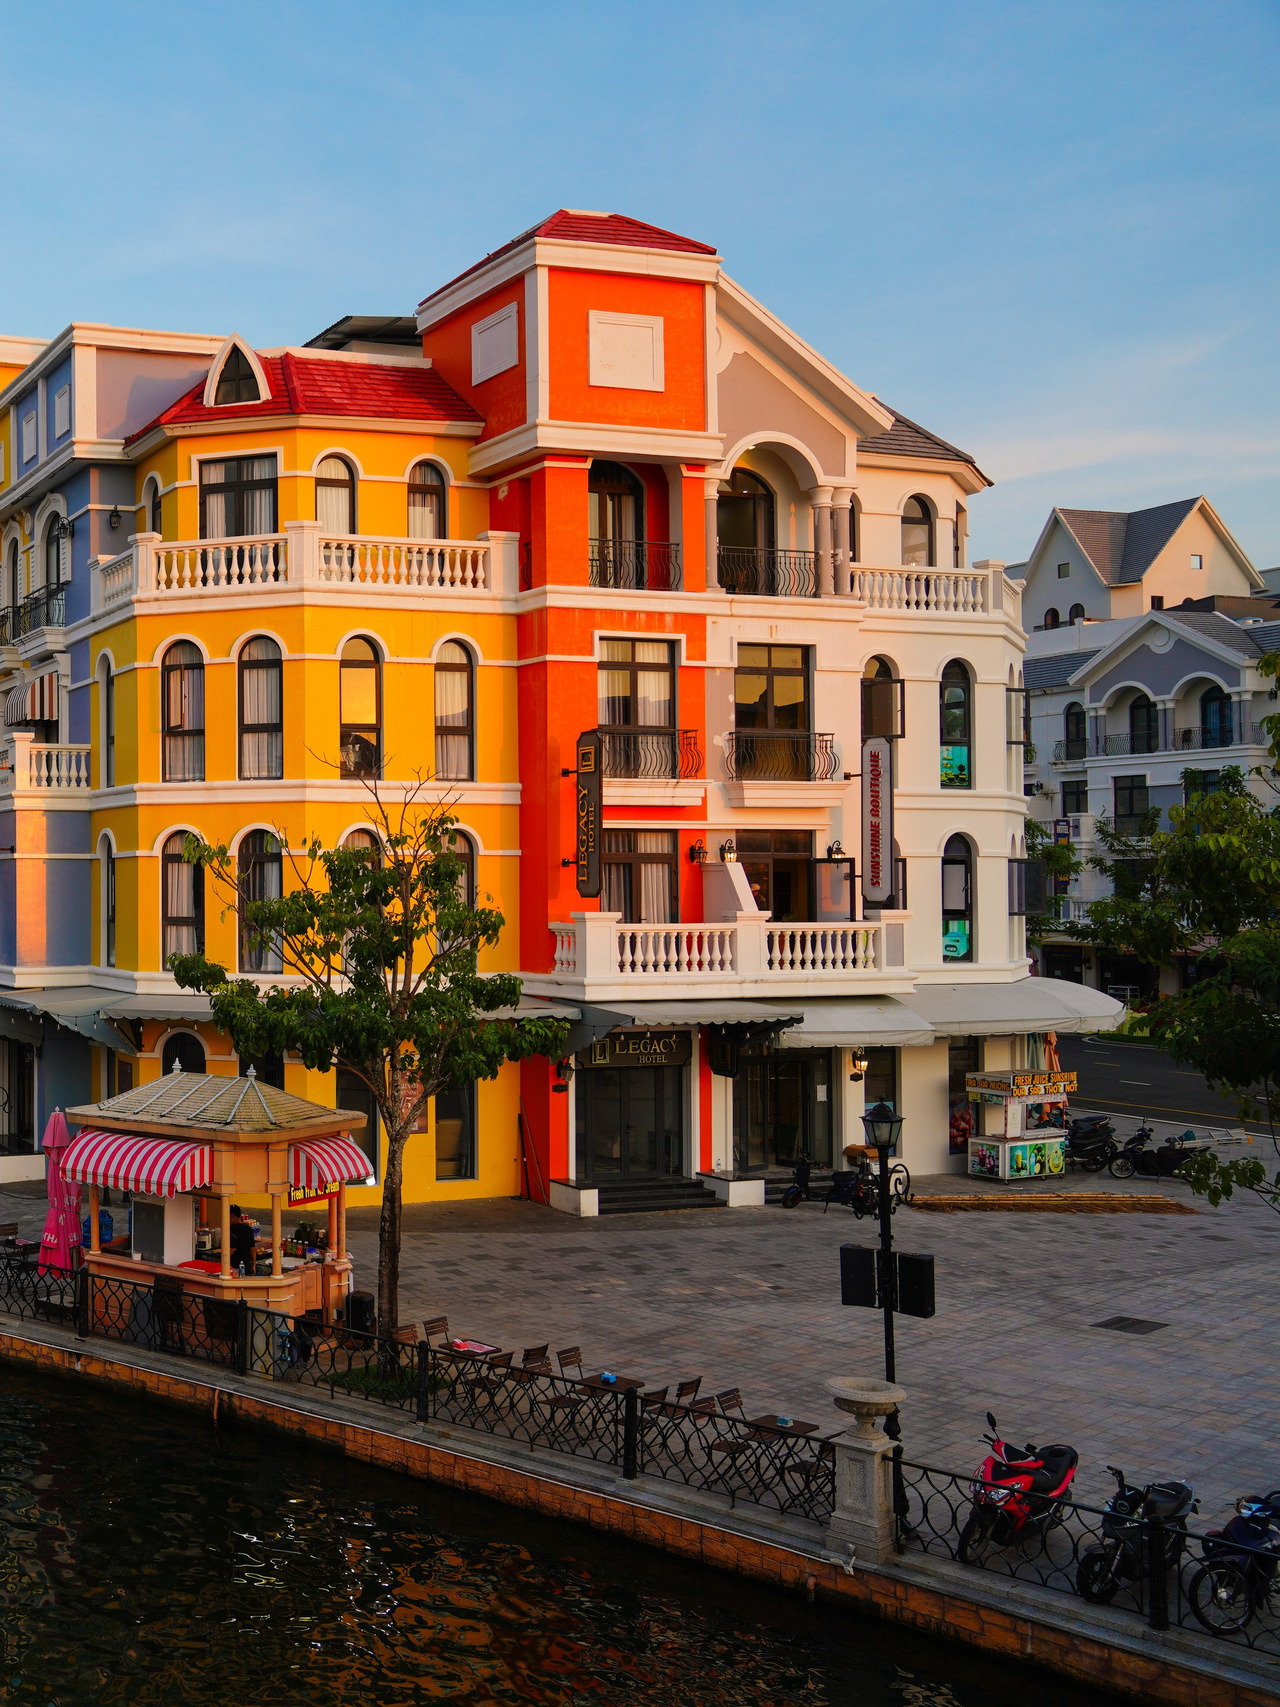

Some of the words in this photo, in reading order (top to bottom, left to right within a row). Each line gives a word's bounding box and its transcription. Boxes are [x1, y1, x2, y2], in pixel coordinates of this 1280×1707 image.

[870, 750, 883, 818] BOUTIQUE
[578, 784, 588, 882] LEGACY
[870, 820, 882, 887] SUNSHINE
[614, 1039, 680, 1054] LEGACY
[639, 1055, 668, 1064] HOTEL
[1014, 1076, 1032, 1086] FRESH
[1033, 1074, 1048, 1084] JUICE
[1050, 1072, 1077, 1083] SUNSHINE
[291, 1187, 304, 1201] Fresh
